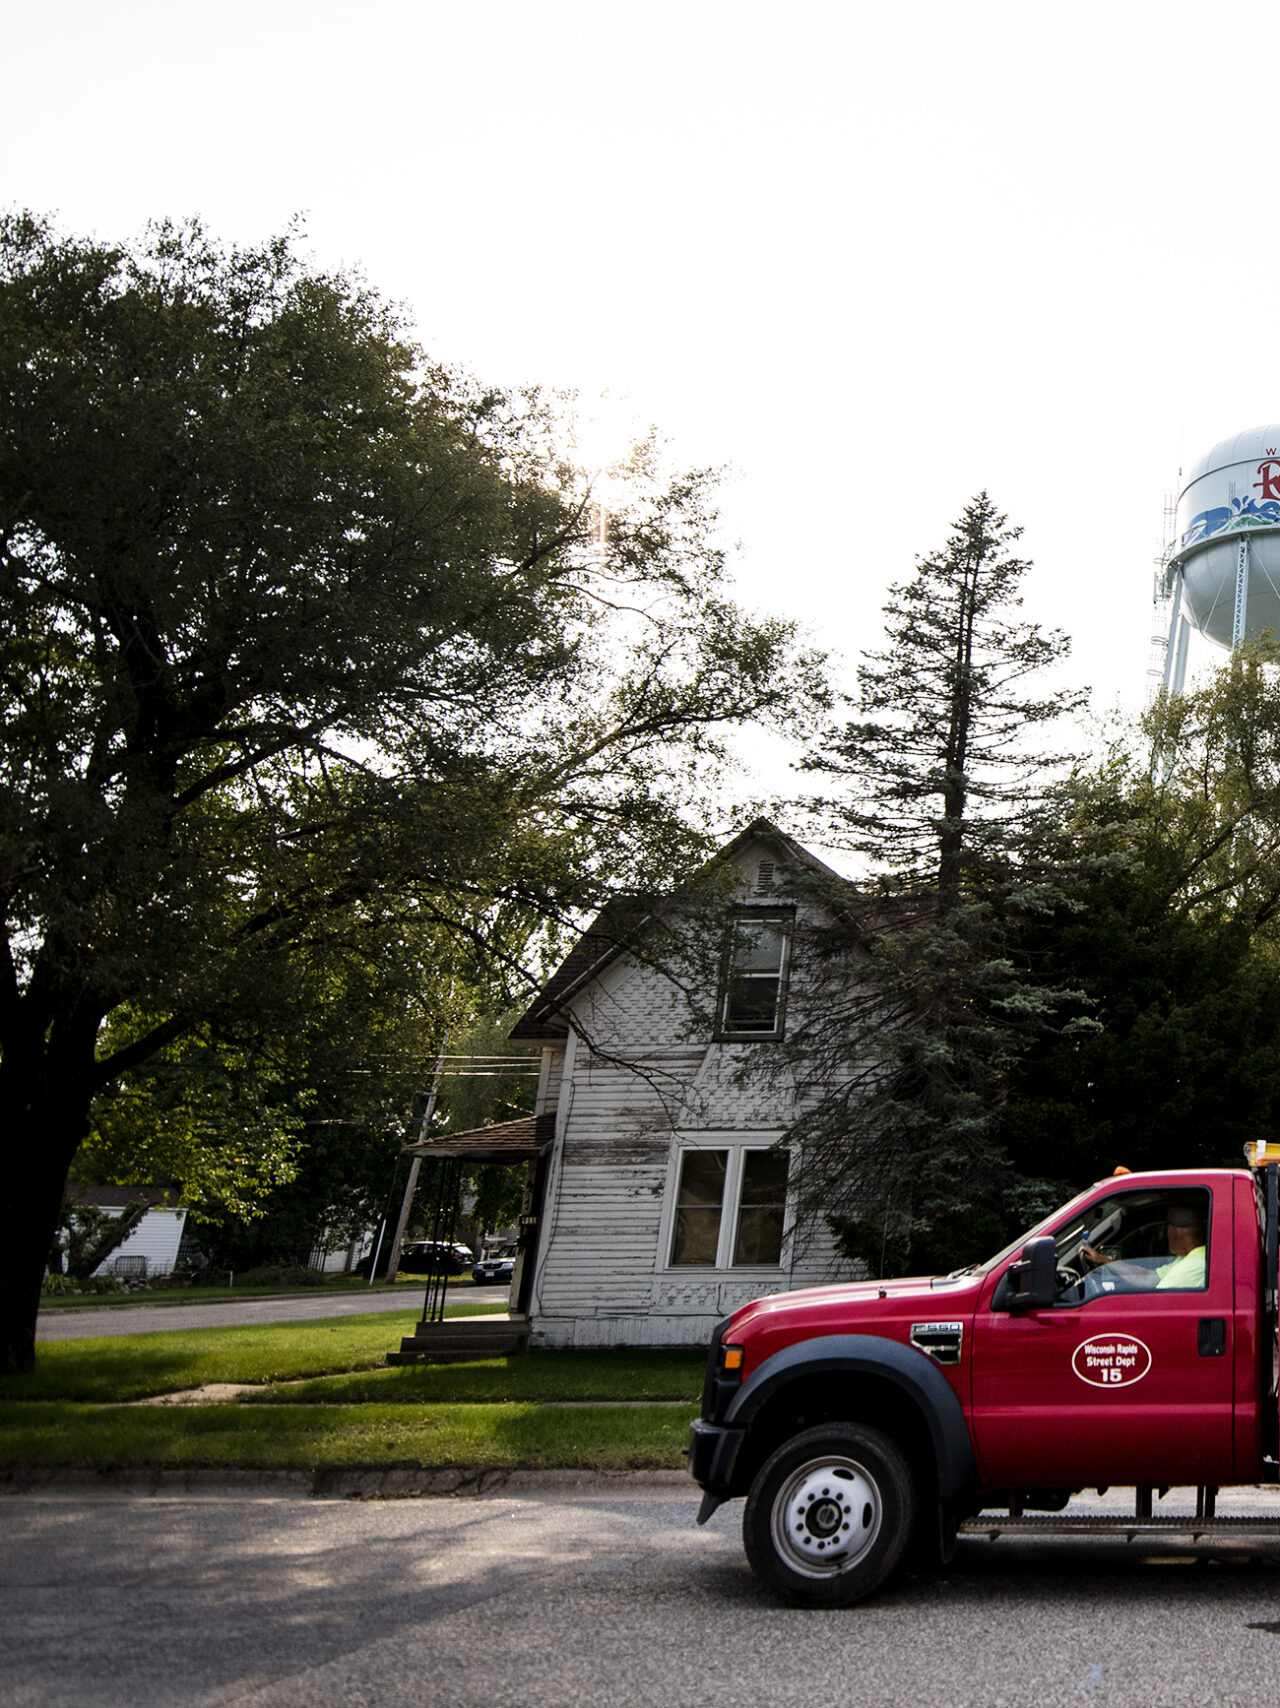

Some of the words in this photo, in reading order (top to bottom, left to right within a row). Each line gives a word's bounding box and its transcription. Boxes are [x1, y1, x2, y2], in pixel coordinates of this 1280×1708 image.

[1084, 1344, 1115, 1354] Wisconsin
[1117, 1344, 1138, 1355] Rapids
[1086, 1356, 1113, 1366] Street
[1115, 1356, 1135, 1367] Dept
[1101, 1368, 1122, 1382] 15
